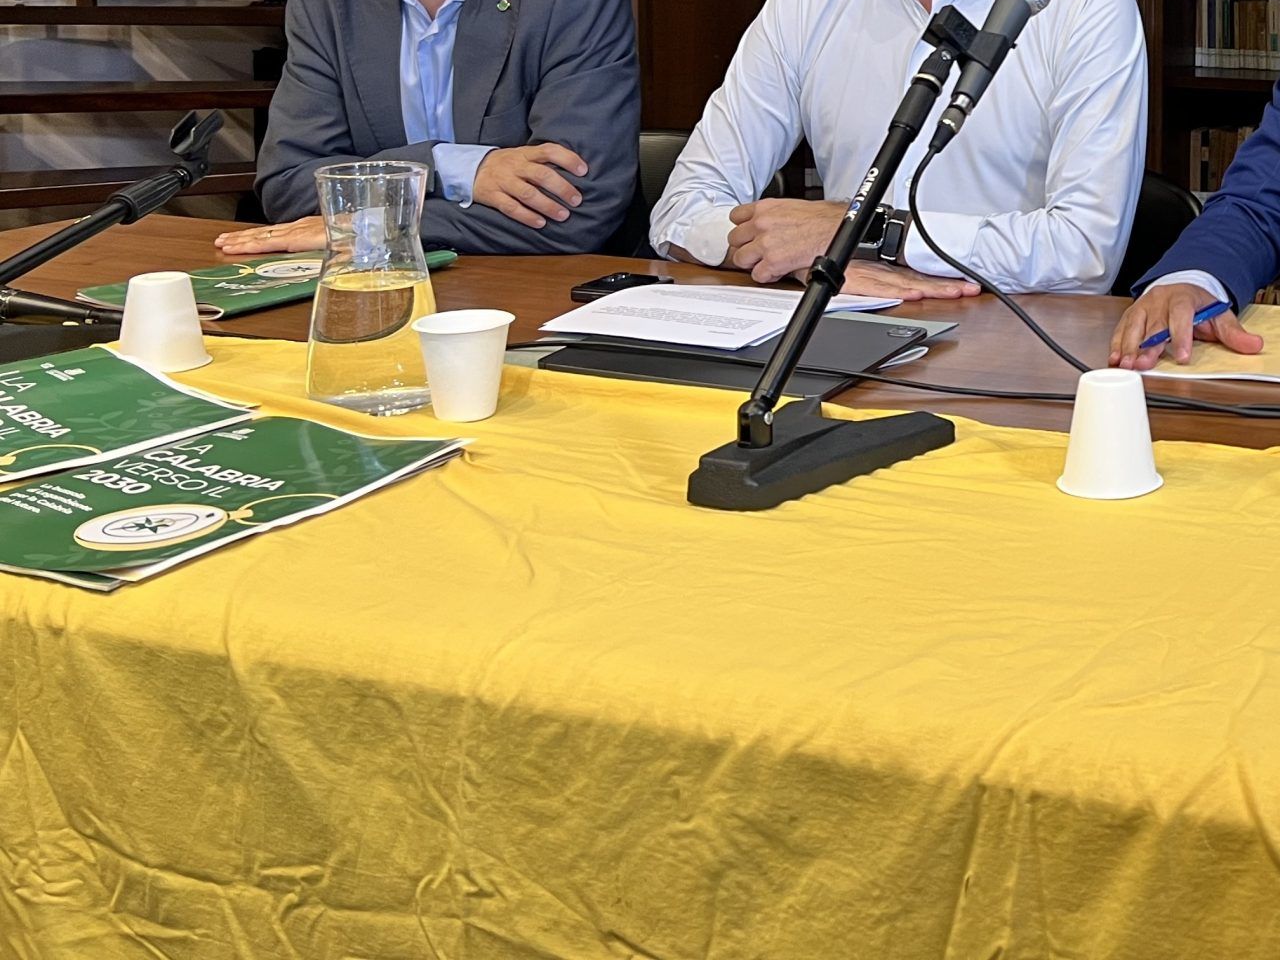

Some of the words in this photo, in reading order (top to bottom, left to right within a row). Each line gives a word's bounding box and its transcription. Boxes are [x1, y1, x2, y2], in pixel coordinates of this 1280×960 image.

[173, 441, 213, 454] LA
[73, 469, 151, 494] 2030
[113, 460, 208, 491] VERSO
[201, 485, 231, 498] IL
[144, 450, 285, 491] CALABRIA
